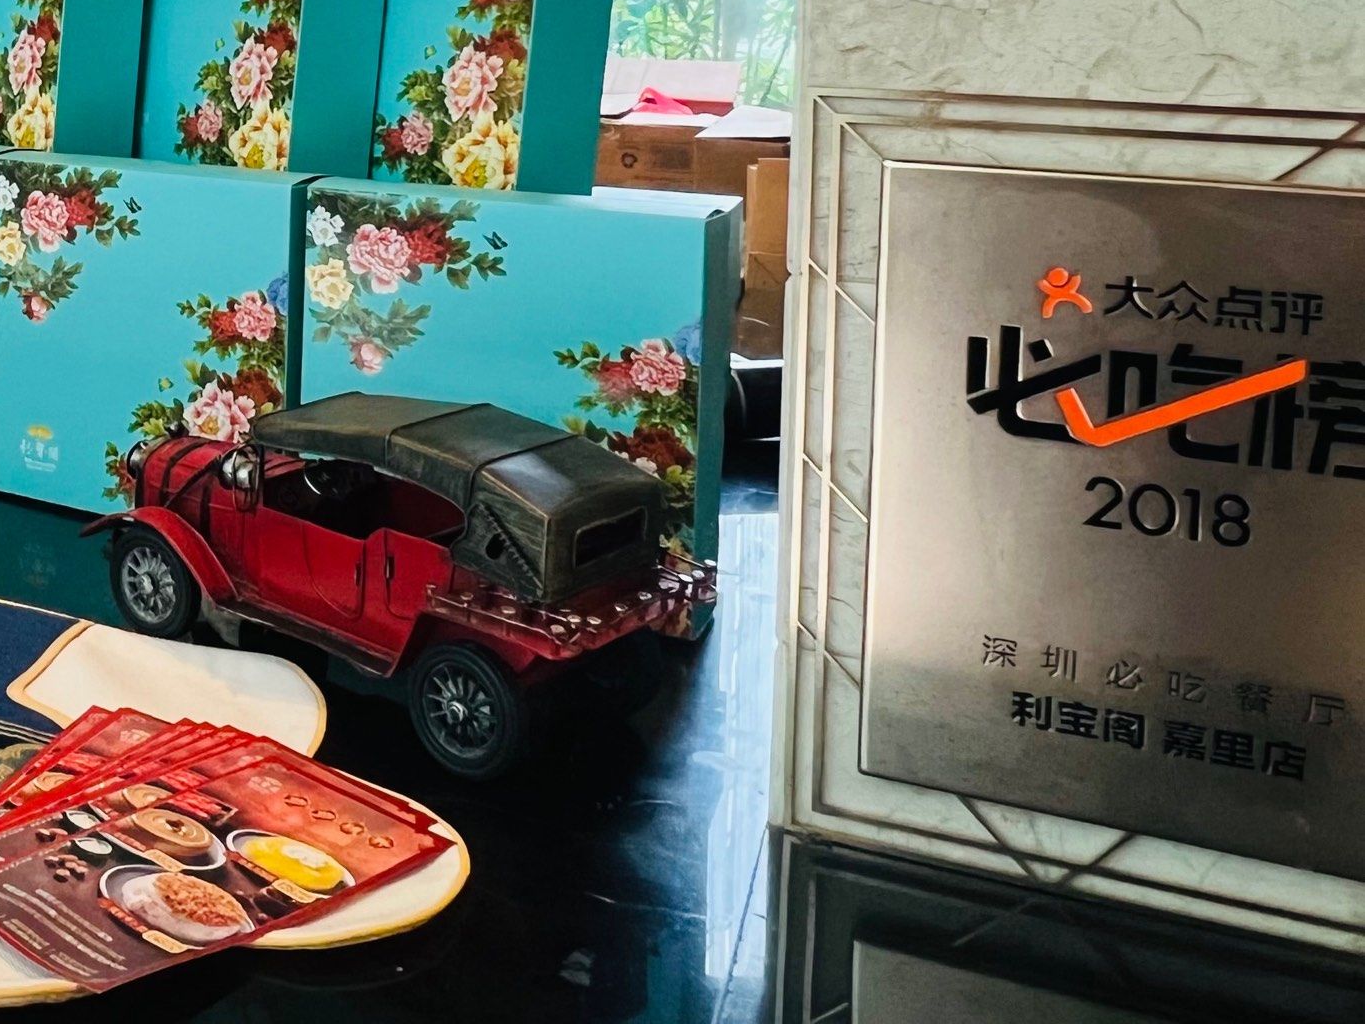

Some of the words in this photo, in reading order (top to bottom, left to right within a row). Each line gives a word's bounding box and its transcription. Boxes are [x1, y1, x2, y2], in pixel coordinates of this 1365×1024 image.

[1103, 275, 1324, 335] 大众点评
[1083, 476, 1251, 547] 2018
[982, 634, 1345, 726] 深圳必吃餐厅
[1011, 691, 1147, 750] 利宝阁
[1164, 720, 1307, 781] 嘉里店
